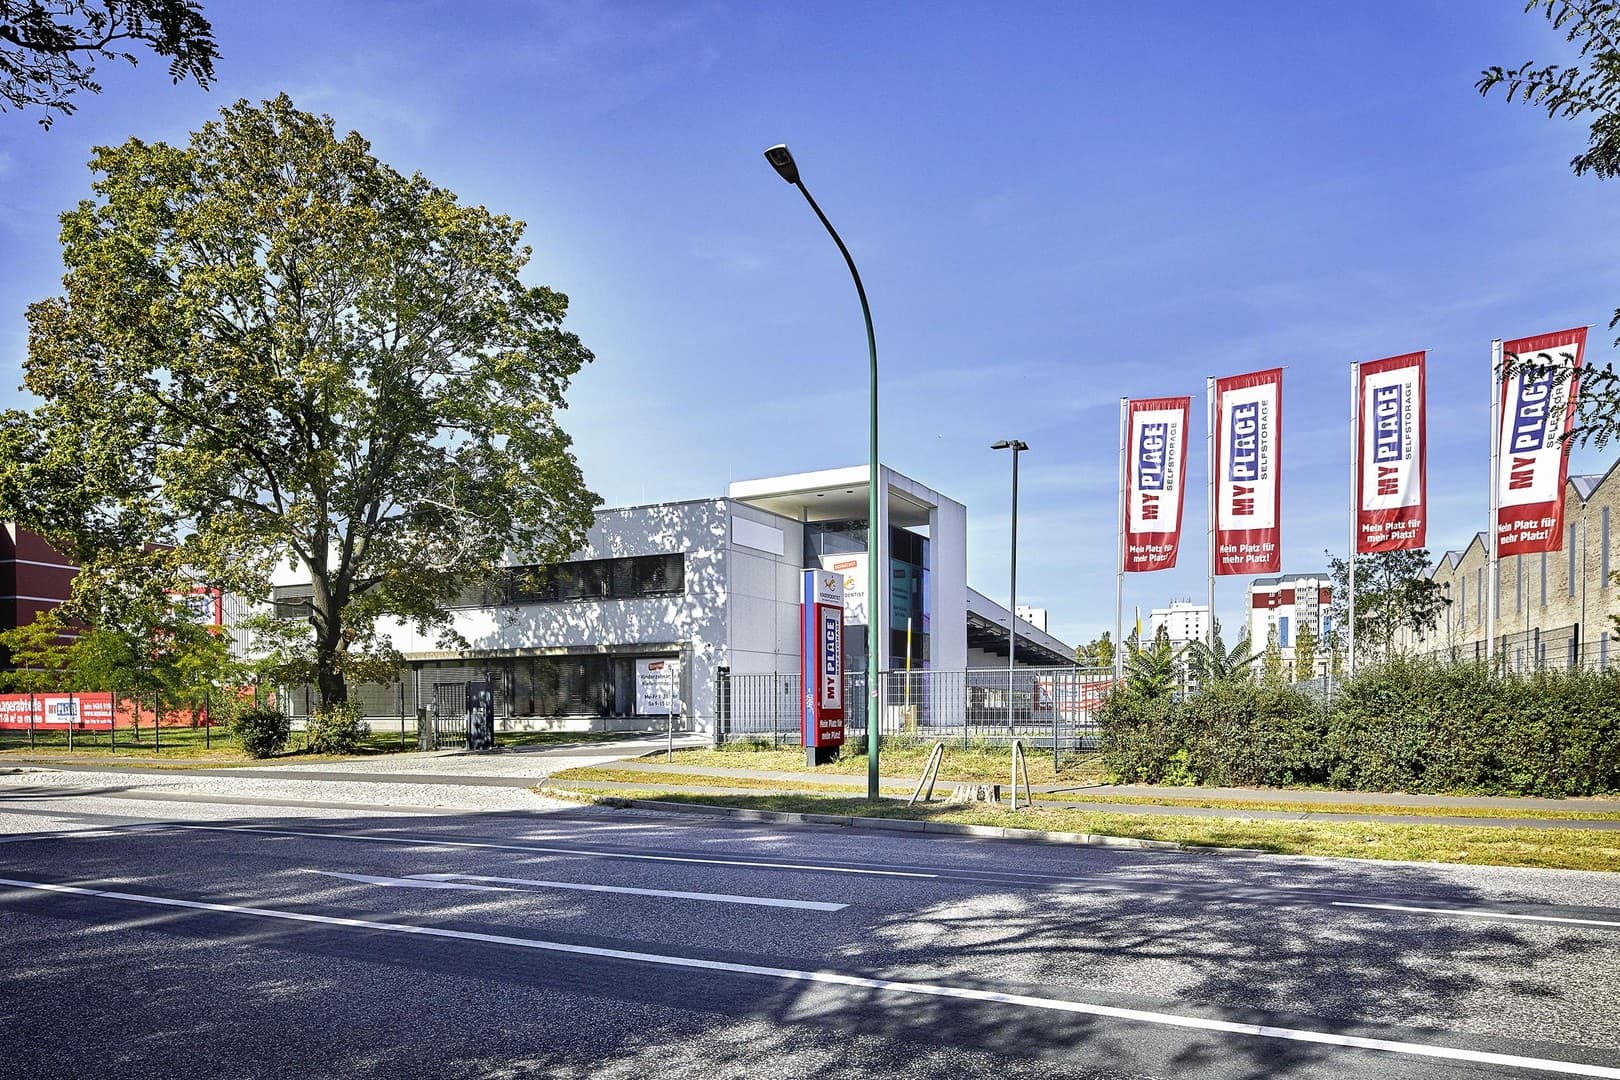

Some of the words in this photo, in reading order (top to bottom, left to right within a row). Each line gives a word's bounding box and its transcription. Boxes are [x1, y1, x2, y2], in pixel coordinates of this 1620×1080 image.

[1375, 386, 1400, 461] PLACE
[1231, 404, 1257, 479] PLACE
[1140, 423, 1166, 488] PLACE
[1167, 422, 1177, 491] SELFSTORAGE
[1378, 466, 1398, 496] MY
[1508, 457, 1536, 490] MY
[1142, 493, 1159, 520] MY
[1232, 485, 1254, 515] MY
[1362, 523, 1383, 533] Mein
[1385, 521, 1406, 530] Platz
[1407, 519, 1421, 528] für
[1514, 519, 1538, 531] Platz
[1540, 517, 1556, 528] für
[1520, 529, 1549, 542] Platz!
[1129, 544, 1144, 553] Mein
[1145, 544, 1162, 552] Platz
[1239, 543, 1260, 553] Platz
[1262, 542, 1275, 551] für
[1367, 533, 1389, 543] mehr
[1391, 530, 1416, 540] Platz!
[1133, 554, 1148, 563] mehr
[1148, 553, 1169, 562] Platz!
[1222, 555, 1244, 564] mehr
[1245, 553, 1270, 563] Platz!
[826, 620, 836, 673] PLACE
[827, 677, 835, 699] MY
